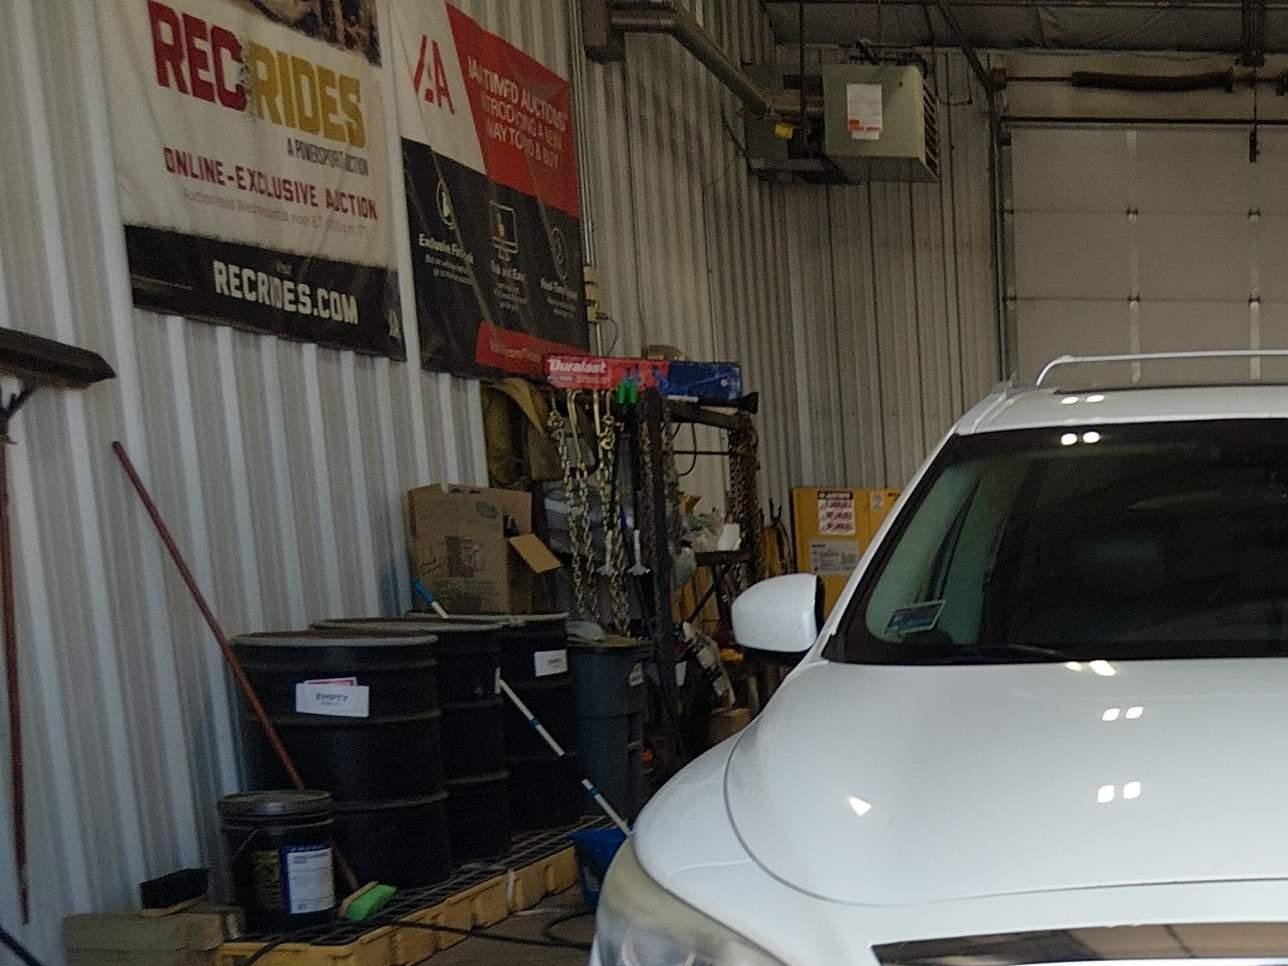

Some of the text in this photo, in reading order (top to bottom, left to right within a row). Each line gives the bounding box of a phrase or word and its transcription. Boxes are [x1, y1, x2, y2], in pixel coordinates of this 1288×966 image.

[163, 147, 319, 208] ONLINE-EXCLUSIVE
[325, 187, 378, 221] AUCTION
[213, 260, 359, 325] RECRIDES.COM
[547, 359, 608, 374] Duralast
